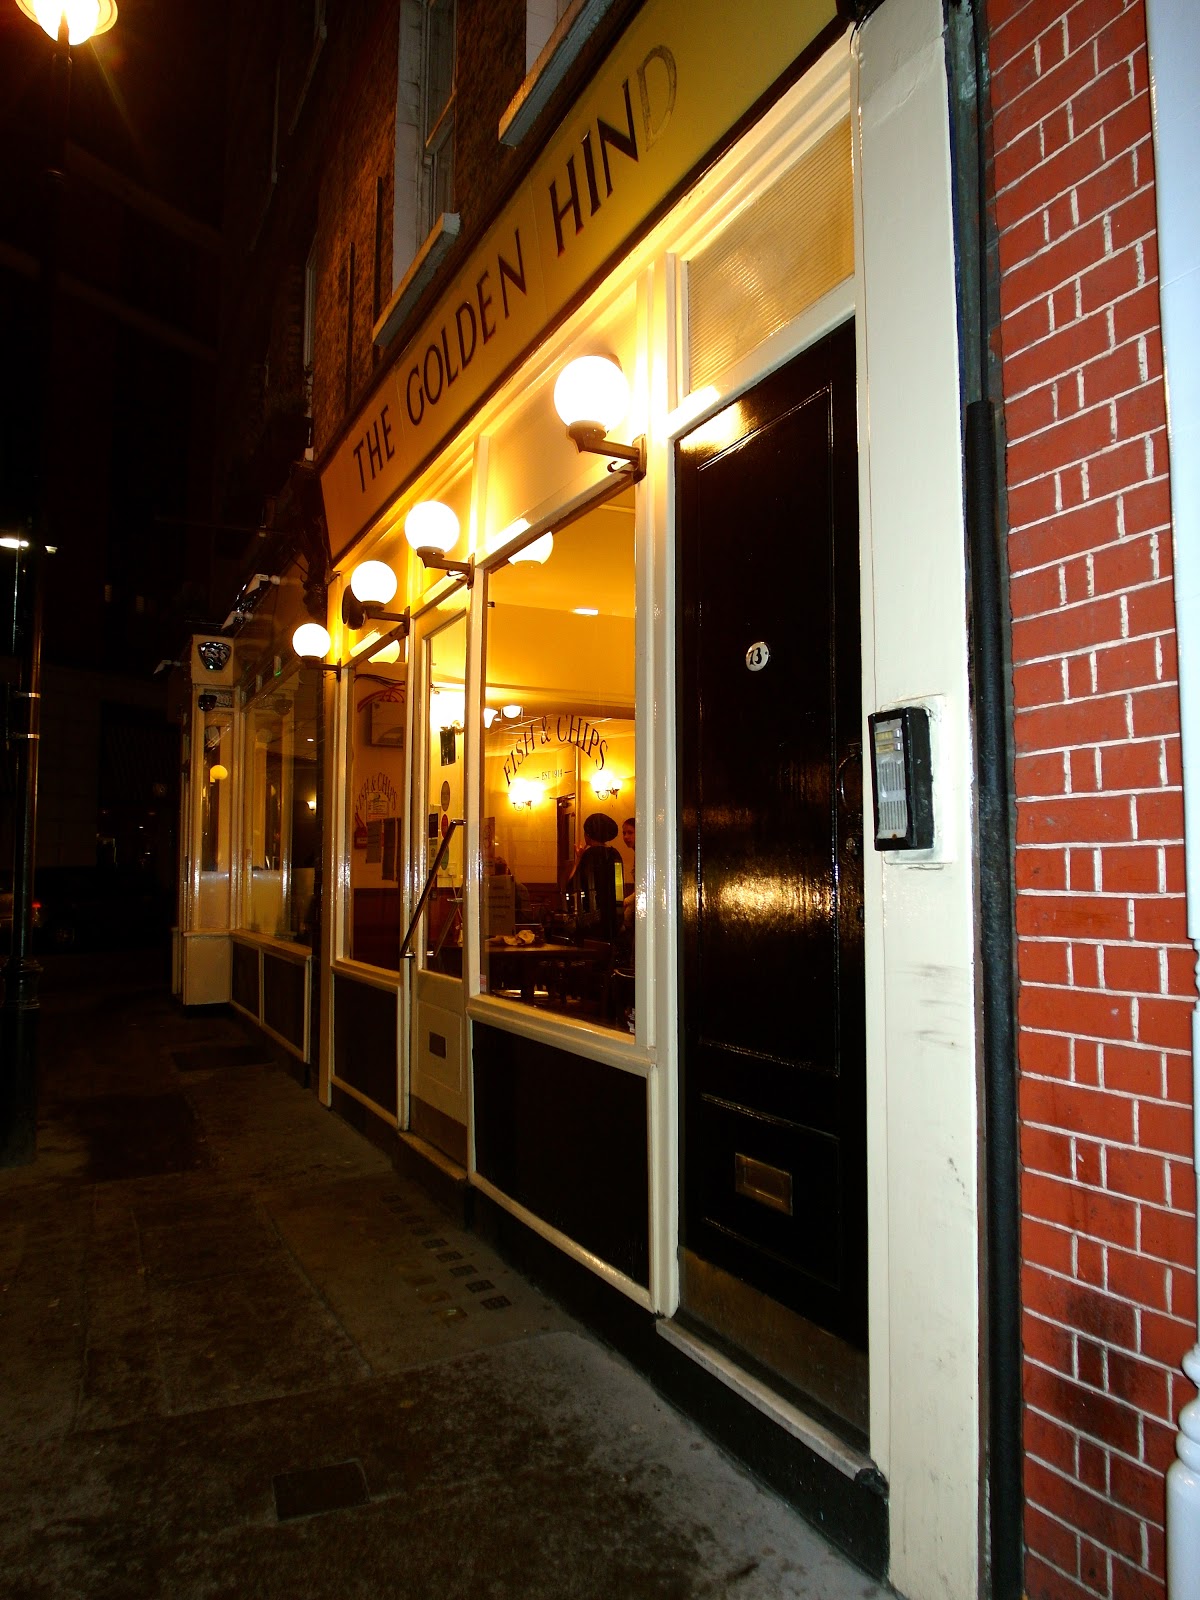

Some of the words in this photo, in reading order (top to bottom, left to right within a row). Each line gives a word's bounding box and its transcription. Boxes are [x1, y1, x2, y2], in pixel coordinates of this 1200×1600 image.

[353, 404, 395, 494] THE
[406, 229, 527, 427] GOLDEN
[549, 44, 677, 258] HIND
[748, 646, 763, 666] 73
[503, 723, 536, 788] FISH
[540, 715, 552, 745] &
[556, 714, 609, 771] CHIPS
